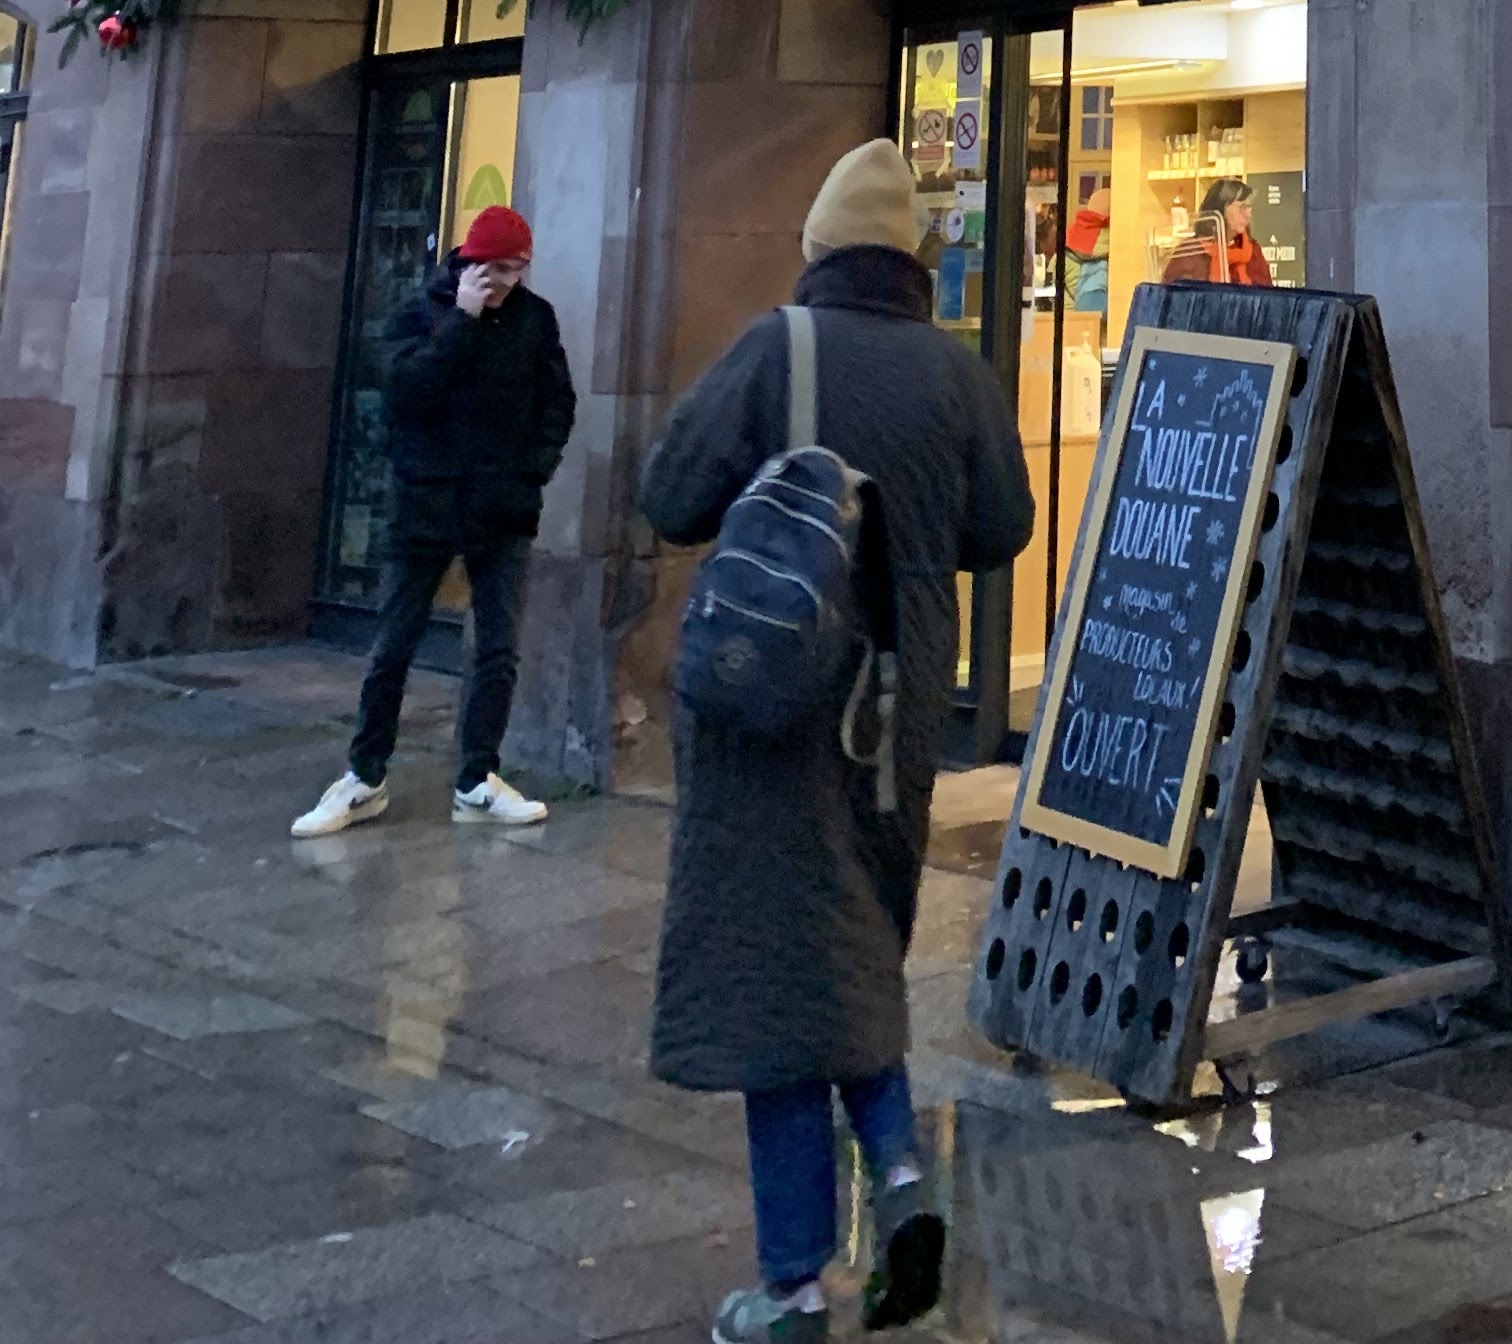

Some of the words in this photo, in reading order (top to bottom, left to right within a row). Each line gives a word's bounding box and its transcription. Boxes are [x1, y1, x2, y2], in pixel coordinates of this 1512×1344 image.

[1131, 378, 1166, 431] LA
[1134, 426, 1248, 502] NOUVELLE
[1109, 496, 1202, 569] DOUANE
[1079, 617, 1174, 673] PRODUCTEURS
[1062, 708, 1170, 793] OUVERT
